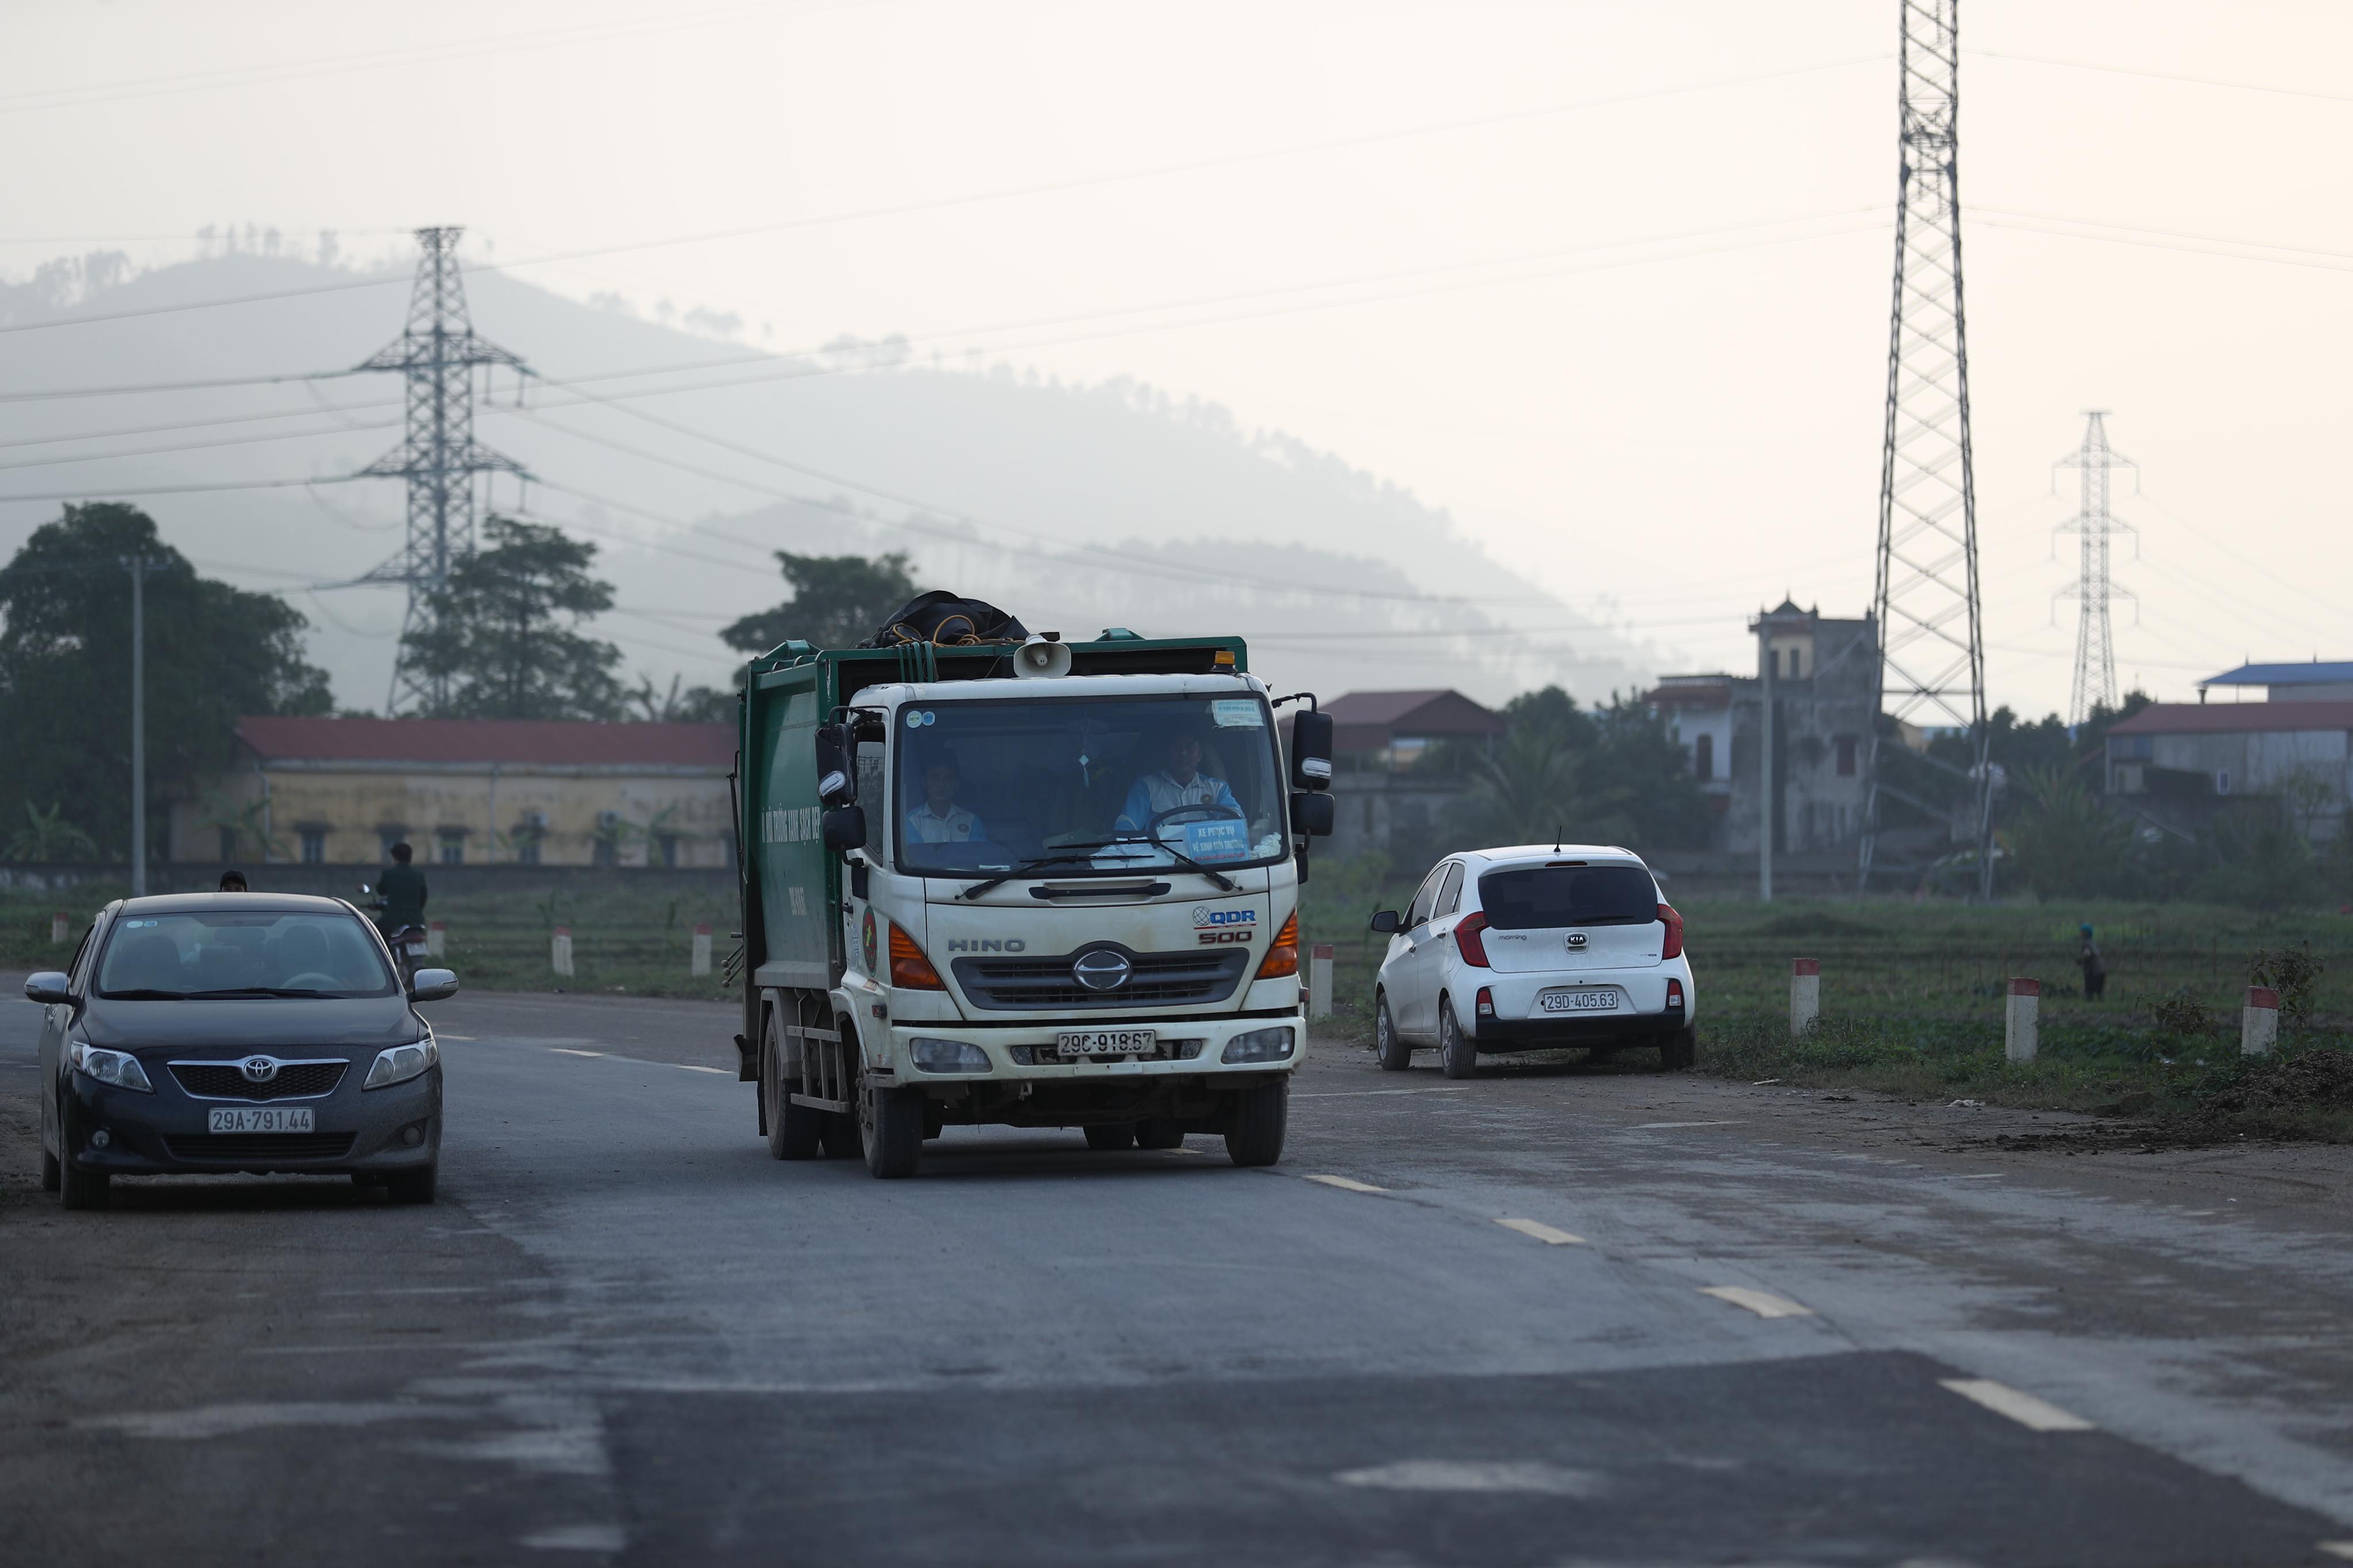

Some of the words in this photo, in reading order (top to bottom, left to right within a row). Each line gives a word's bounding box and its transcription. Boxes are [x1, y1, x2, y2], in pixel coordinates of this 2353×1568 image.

[773, 802, 788, 843] TRƯỜNG
[788, 809, 799, 842] XANH
[800, 807, 811, 845] SẠCH
[812, 806, 820, 844] ĐẸP
[1198, 828, 1206, 837] XE
[1208, 827, 1225, 837] PHỤC
[1226, 826, 1235, 836] VỤ
[1192, 841, 1199, 853] VỆ
[1200, 841, 1213, 851] SINH
[1213, 840, 1224, 850] MÔI
[1224, 838, 1244, 849] TRƯỜNG
[1210, 910, 1256, 924] QDR
[948, 939, 1025, 952] HINO
[1199, 931, 1252, 945] 500
[1547, 993, 1615, 1009] 29D-405.63
[1061, 1033, 1152, 1053] 29C-918.67
[213, 1111, 310, 1130] 29A-791.44
